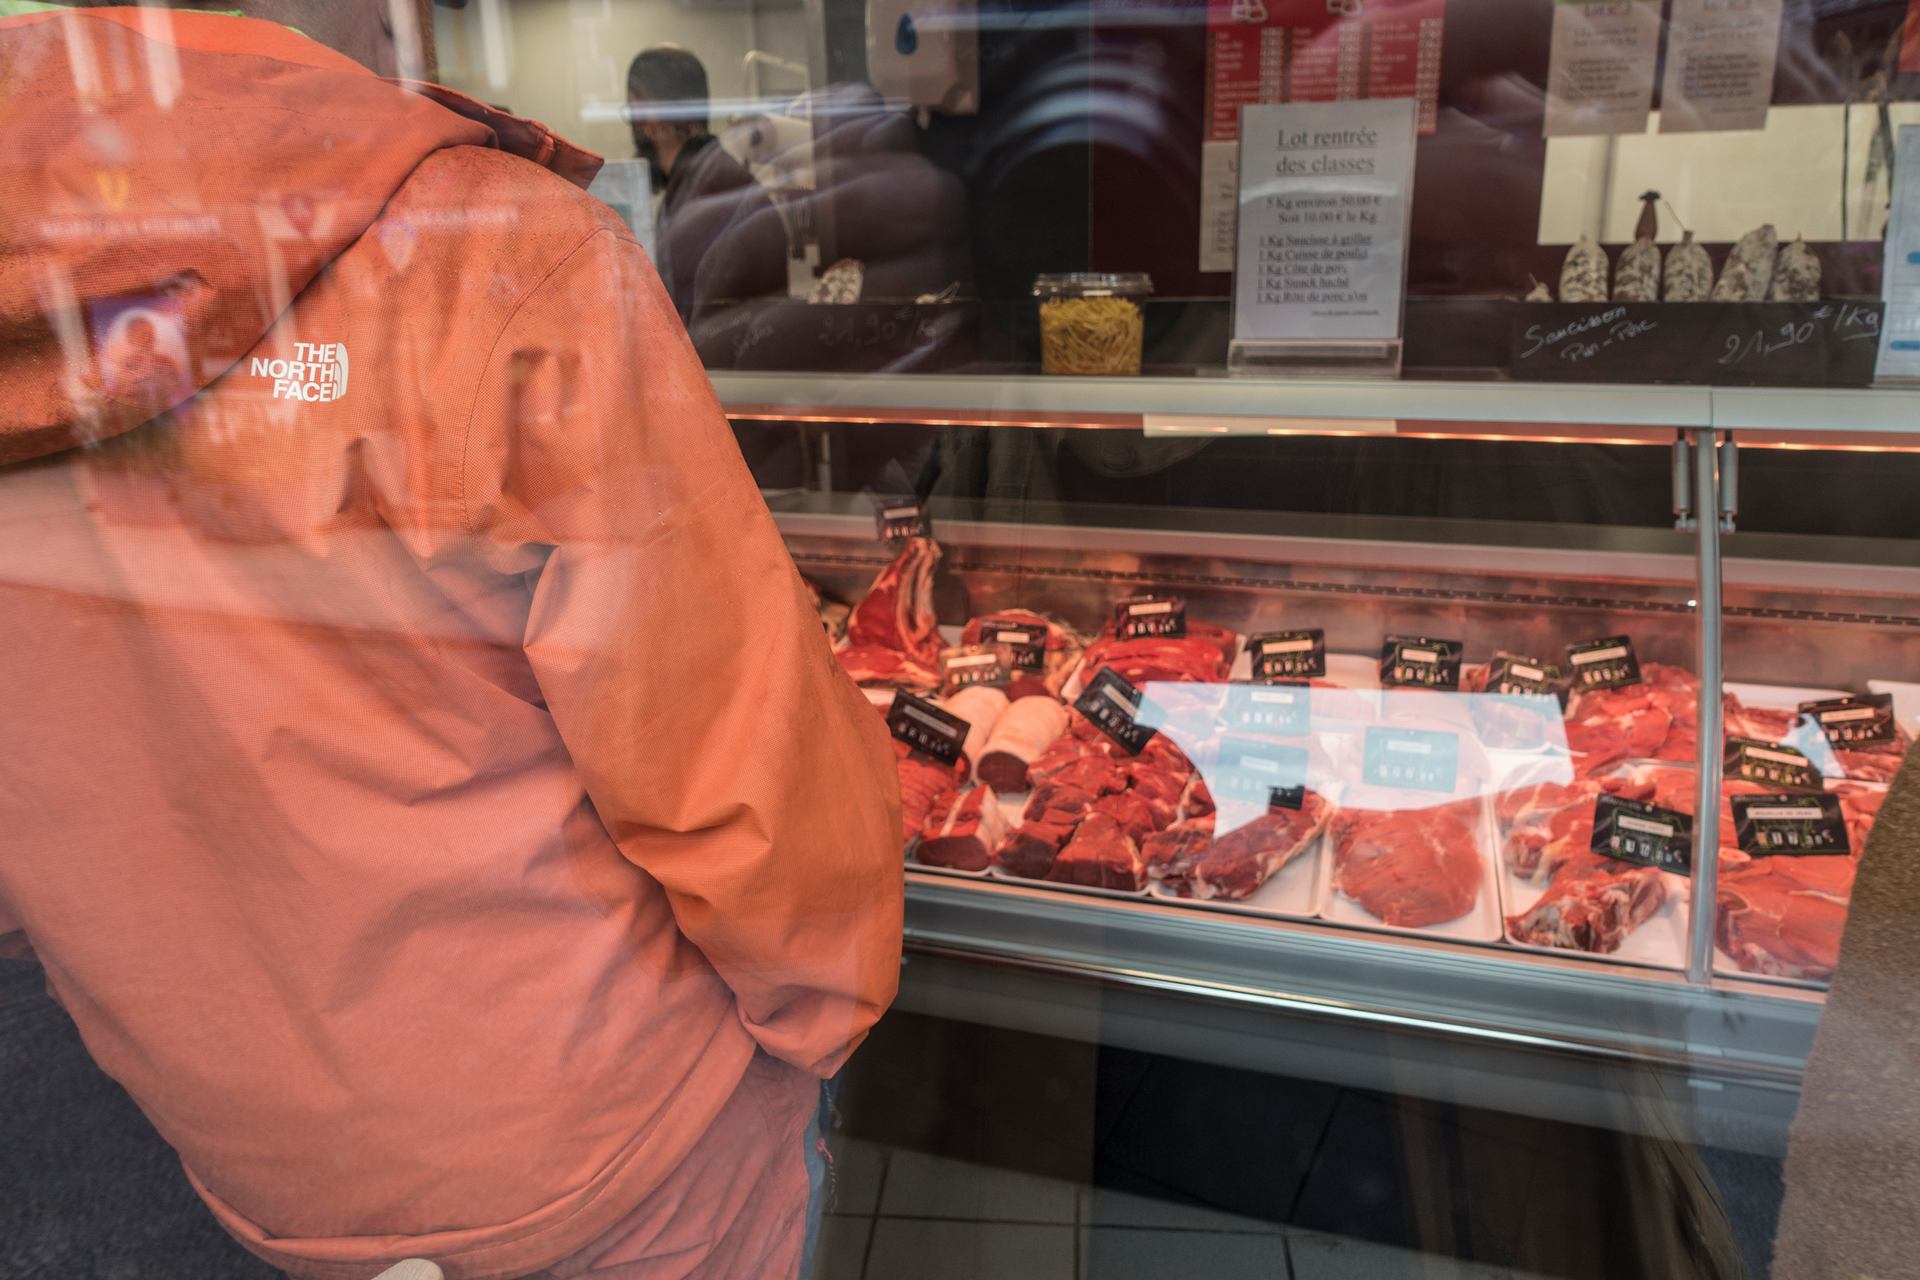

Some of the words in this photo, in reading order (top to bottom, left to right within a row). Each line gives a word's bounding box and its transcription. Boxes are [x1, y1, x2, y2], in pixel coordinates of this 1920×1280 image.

[1278, 129, 1308, 148] Lot
[1314, 126, 1378, 146] rentrée
[1276, 156, 1306, 173] des
[1311, 154, 1375, 172] classes
[1276, 198, 1292, 210] Kg
[1295, 198, 1337, 208] environ
[1278, 213, 1299, 224] Soit
[1346, 212, 1356, 222] le
[1359, 211, 1377, 224] Kg
[1268, 235, 1284, 247] Kg
[1267, 250, 1282, 261] Kg
[1321, 249, 1333, 259] de
[1266, 264, 1281, 275] Kg
[1310, 263, 1322, 273] de
[1266, 278, 1281, 289] Kg
[1266, 292, 1280, 304] Kg
[1307, 291, 1319, 302] de
[1520, 304, 1627, 358] Saucisson
[294, 342, 336, 362] THE
[251, 358, 334, 382] NORTH
[273, 379, 332, 402] FACE
